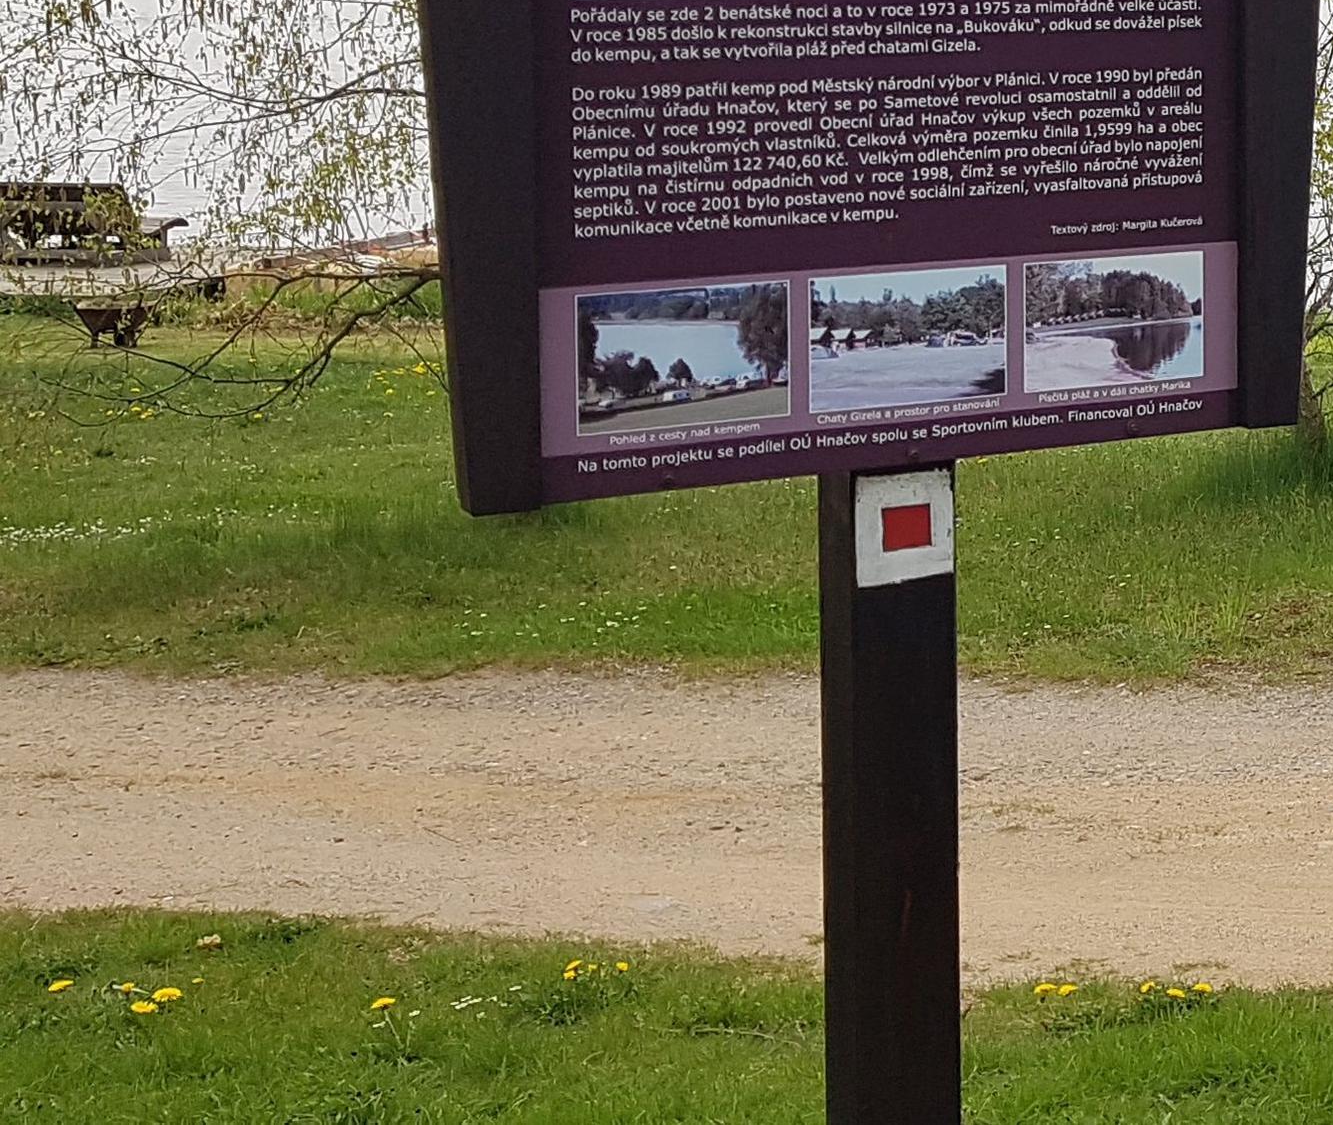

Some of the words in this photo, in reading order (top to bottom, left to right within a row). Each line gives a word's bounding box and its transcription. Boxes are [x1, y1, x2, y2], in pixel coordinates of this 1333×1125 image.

[570, 29, 582, 42] V
[587, 30, 621, 42] roce
[627, 26, 666, 41] 1985
[671, 25, 713, 40] došlo
[718, 25, 726, 38] k
[731, 23, 827, 38] rekonstrukci
[832, 22, 882, 37] stavby
[886, 21, 932, 35] silnice
[936, 23, 953, 33] na
[1049, 17, 1091, 31] odkud
[1095, 20, 1110, 29] se
[1113, 15, 1164, 29] dovážel
[1168, 14, 1202, 30] písek
[571, 48, 591, 62] do
[595, 47, 655, 63] kempu,
[661, 49, 669, 59] a
[674, 45, 699, 59] tak
[703, 47, 720, 58] se
[724, 42, 792, 60] vytvořila
[796, 41, 827, 59] pláž
[831, 40, 865, 57] před
[868, 39, 928, 54] chatami
[932, 38, 980, 52] Gizela.
[575, 220, 672, 237] komunikace
[676, 214, 729, 231] včetně
[733, 211, 827, 227] komunikace
[830, 211, 839, 221] v
[843, 208, 898, 222] kempu.
[1050, 222, 1088, 234] Textový
[1091, 222, 1118, 232] zdroj:
[578, 460, 597, 472] Na
[603, 456, 646, 470] tomto
[652, 449, 712, 467] projektu
[717, 447, 733, 457] se
[739, 439, 784, 457] podílel
[817, 432, 867, 447] Hnačov
[872, 428, 907, 444] spolu
[912, 428, 927, 439] se
[932, 417, 1007, 437] Sportovním
[1012, 414, 1063, 427] klubem.
[1068, 405, 1132, 421] Financoval
[1159, 399, 1202, 413] Hnačov
[610, 433, 646, 444] Pohled
[659, 431, 687, 440] cesty
[690, 426, 710, 436] nad
